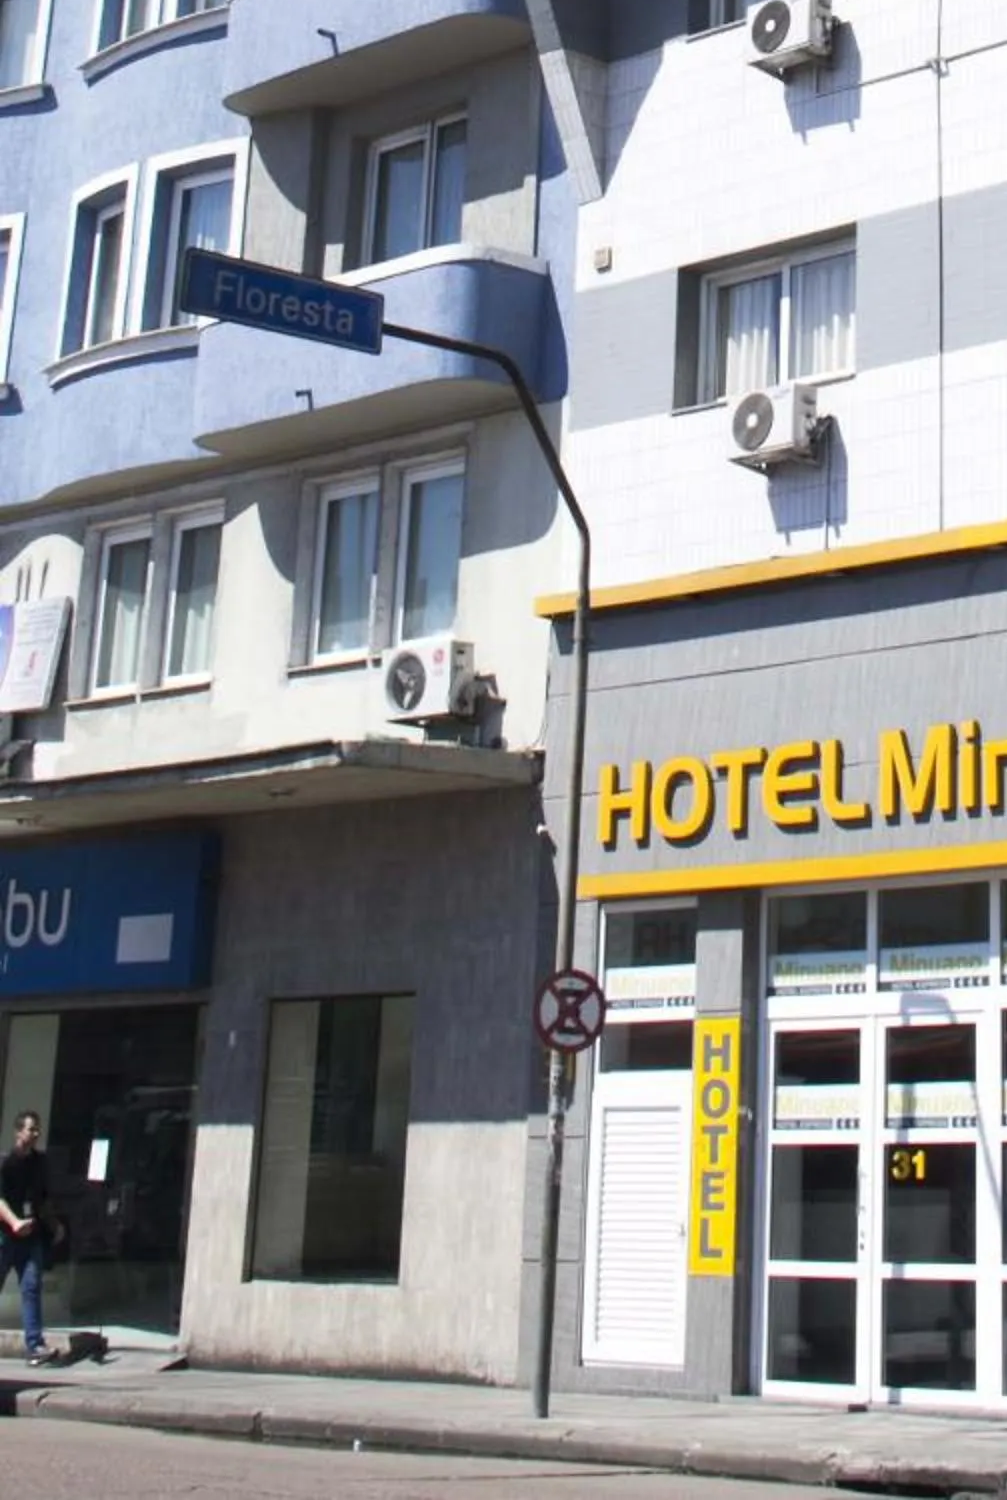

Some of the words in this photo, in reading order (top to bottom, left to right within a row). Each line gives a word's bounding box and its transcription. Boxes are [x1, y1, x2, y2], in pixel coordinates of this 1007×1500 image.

[213, 270, 354, 335] Floresta
[598, 737, 871, 847] HOTEL
[0, 878, 71, 948] bu
[775, 958, 864, 977] Minuano
[890, 951, 983, 973] Minuano
[699, 1033, 731, 1259] HOTEL
[892, 1150, 926, 1181] 31
